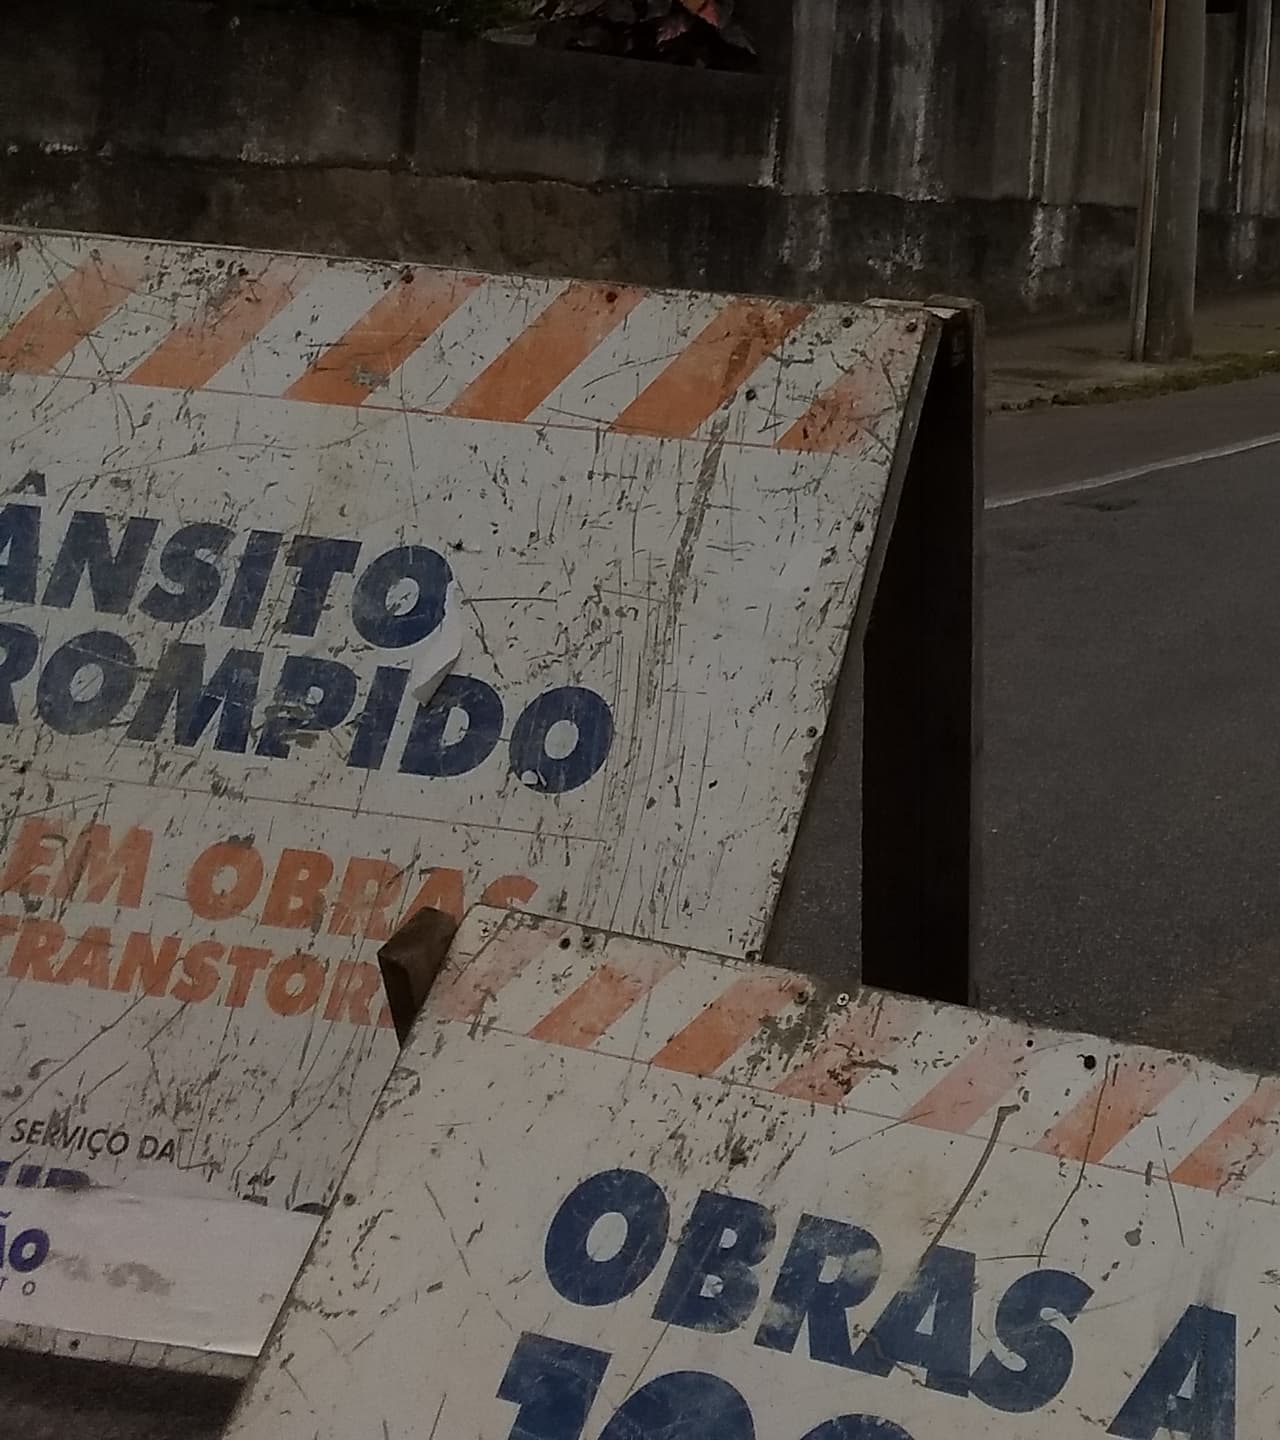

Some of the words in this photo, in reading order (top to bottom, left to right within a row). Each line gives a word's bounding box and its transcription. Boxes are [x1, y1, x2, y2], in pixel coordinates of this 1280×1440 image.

[0, 817, 153, 909] EM
[10, 1117, 131, 1161] SERVIÇO
[136, 1135, 176, 1163] DA
[544, 1168, 1096, 1414] OBRAS
[1105, 1303, 1238, 1440] A
